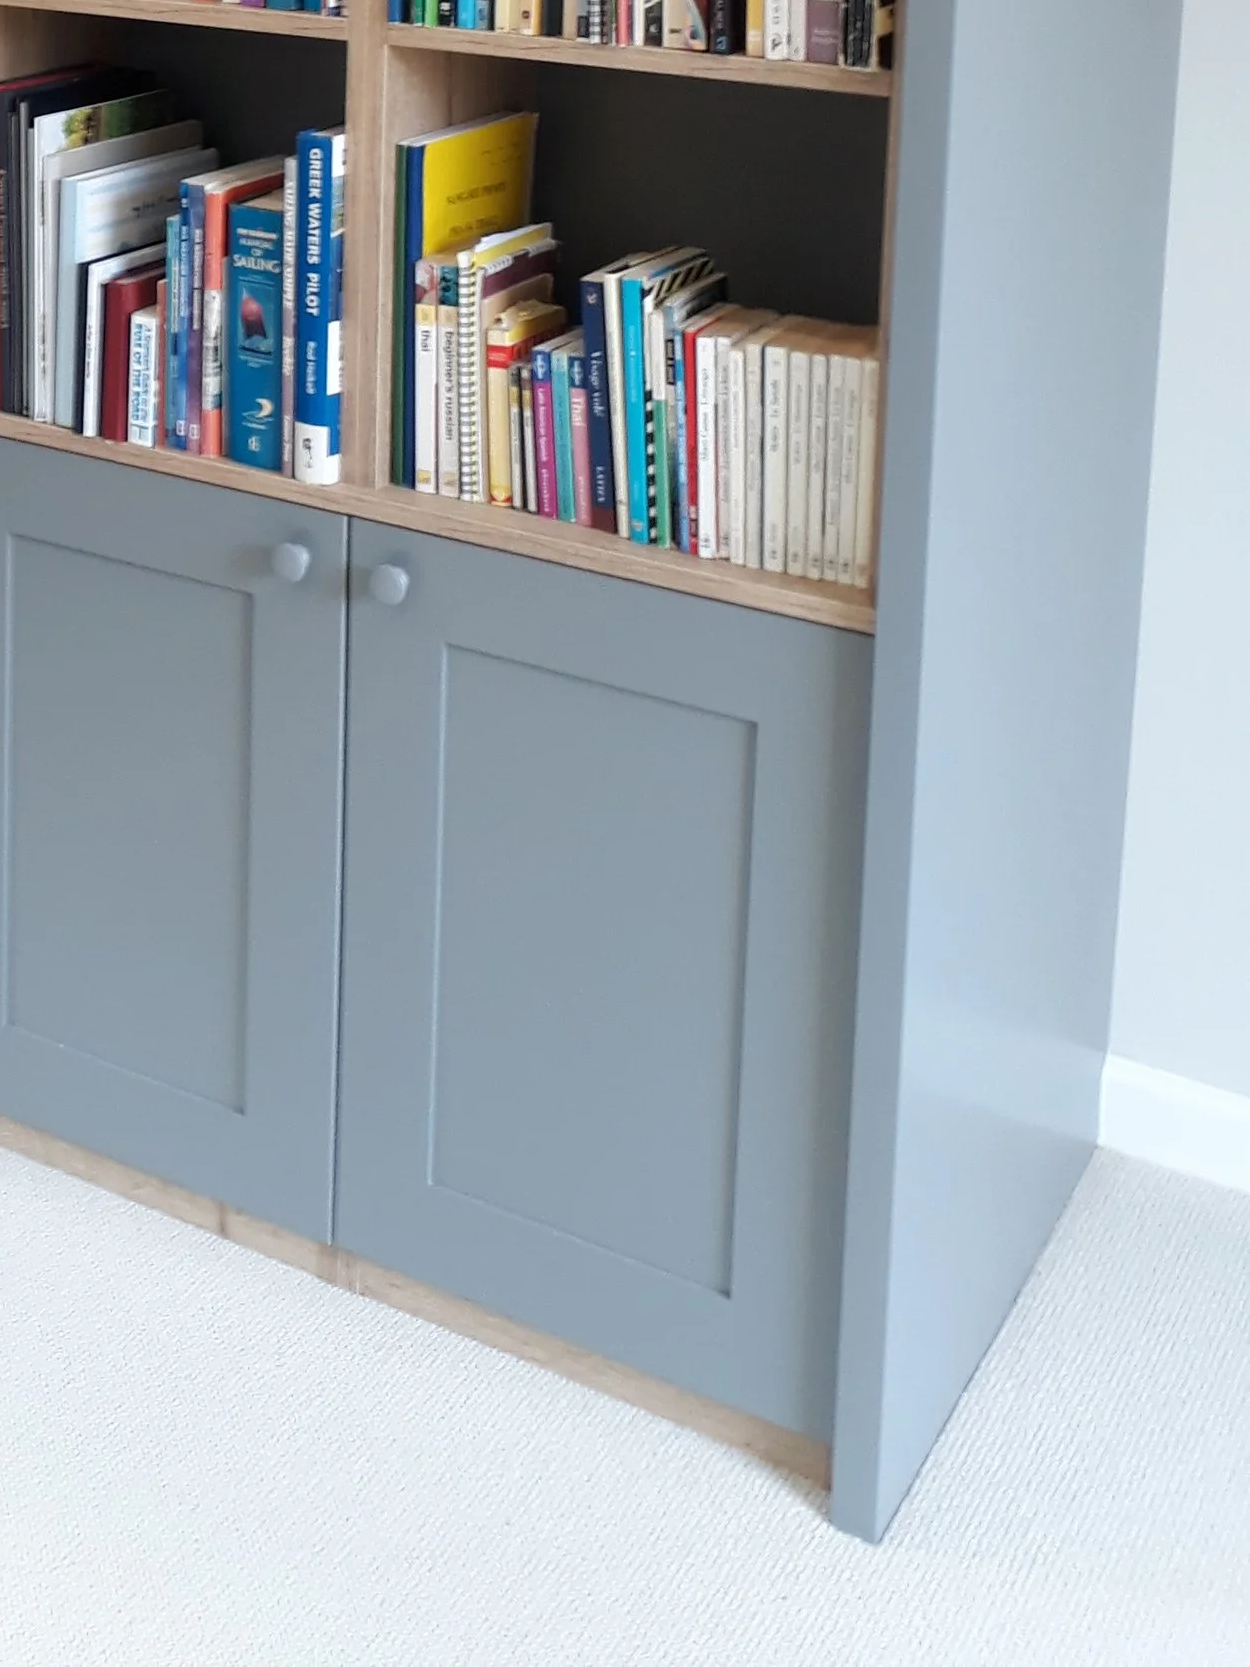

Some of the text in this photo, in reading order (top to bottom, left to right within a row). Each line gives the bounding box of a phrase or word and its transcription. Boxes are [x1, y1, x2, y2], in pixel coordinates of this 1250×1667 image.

[305, 147, 323, 316] GREEK WATERS PILOT
[233, 253, 281, 274] SAILING
[306, 340, 316, 359] Rod
[420, 330, 432, 353] thai
[443, 330, 457, 441] beginner's russian
[589, 350, 604, 390] Visage
[571, 396, 586, 427] Thai
